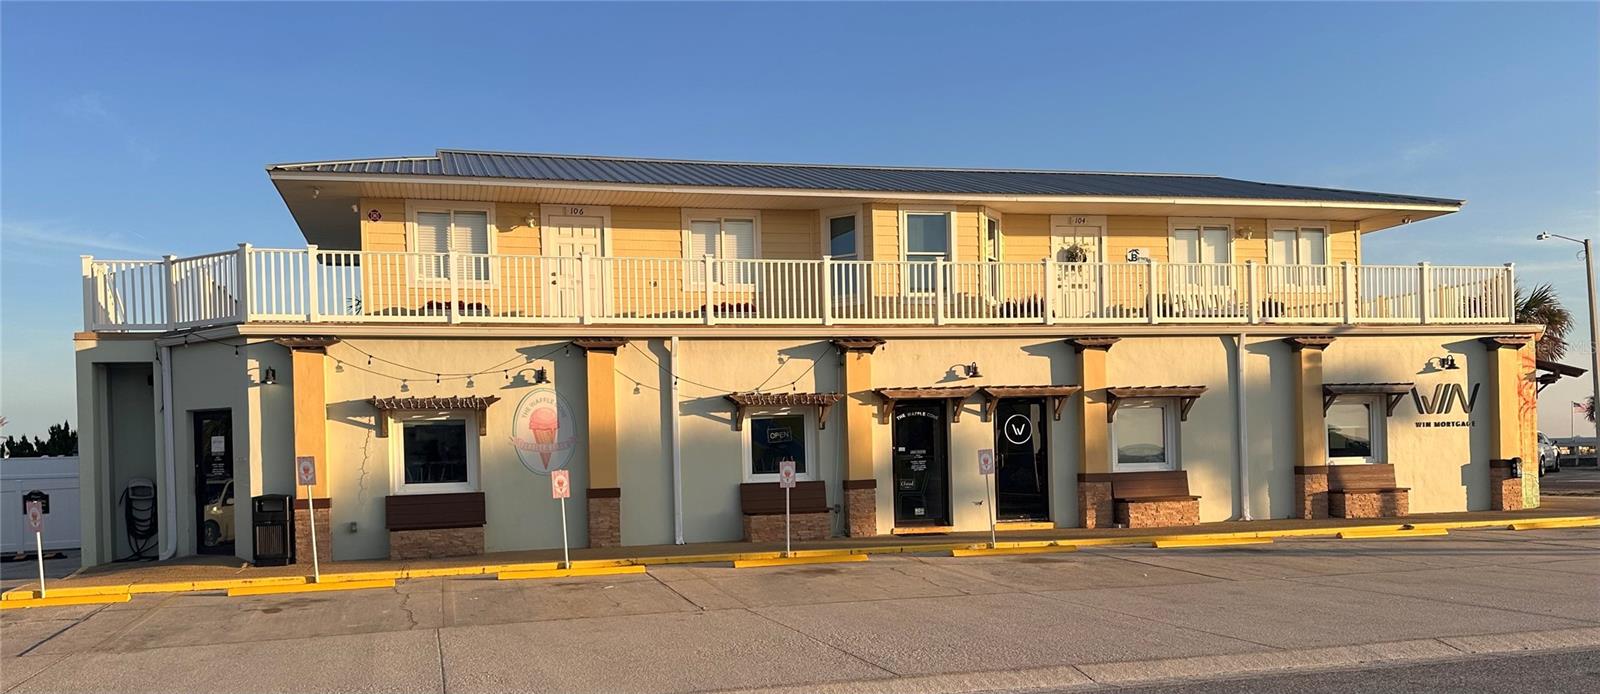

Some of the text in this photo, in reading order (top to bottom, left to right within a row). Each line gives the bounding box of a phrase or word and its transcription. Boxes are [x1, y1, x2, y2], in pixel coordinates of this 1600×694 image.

[570, 207, 584, 215] 106
[1410, 383, 1481, 415] WIN
[896, 413, 906, 421] THE
[1434, 420, 1476, 428] MORTGAGE
[1011, 423, 1026, 436] W
[769, 431, 790, 440] OPEN
